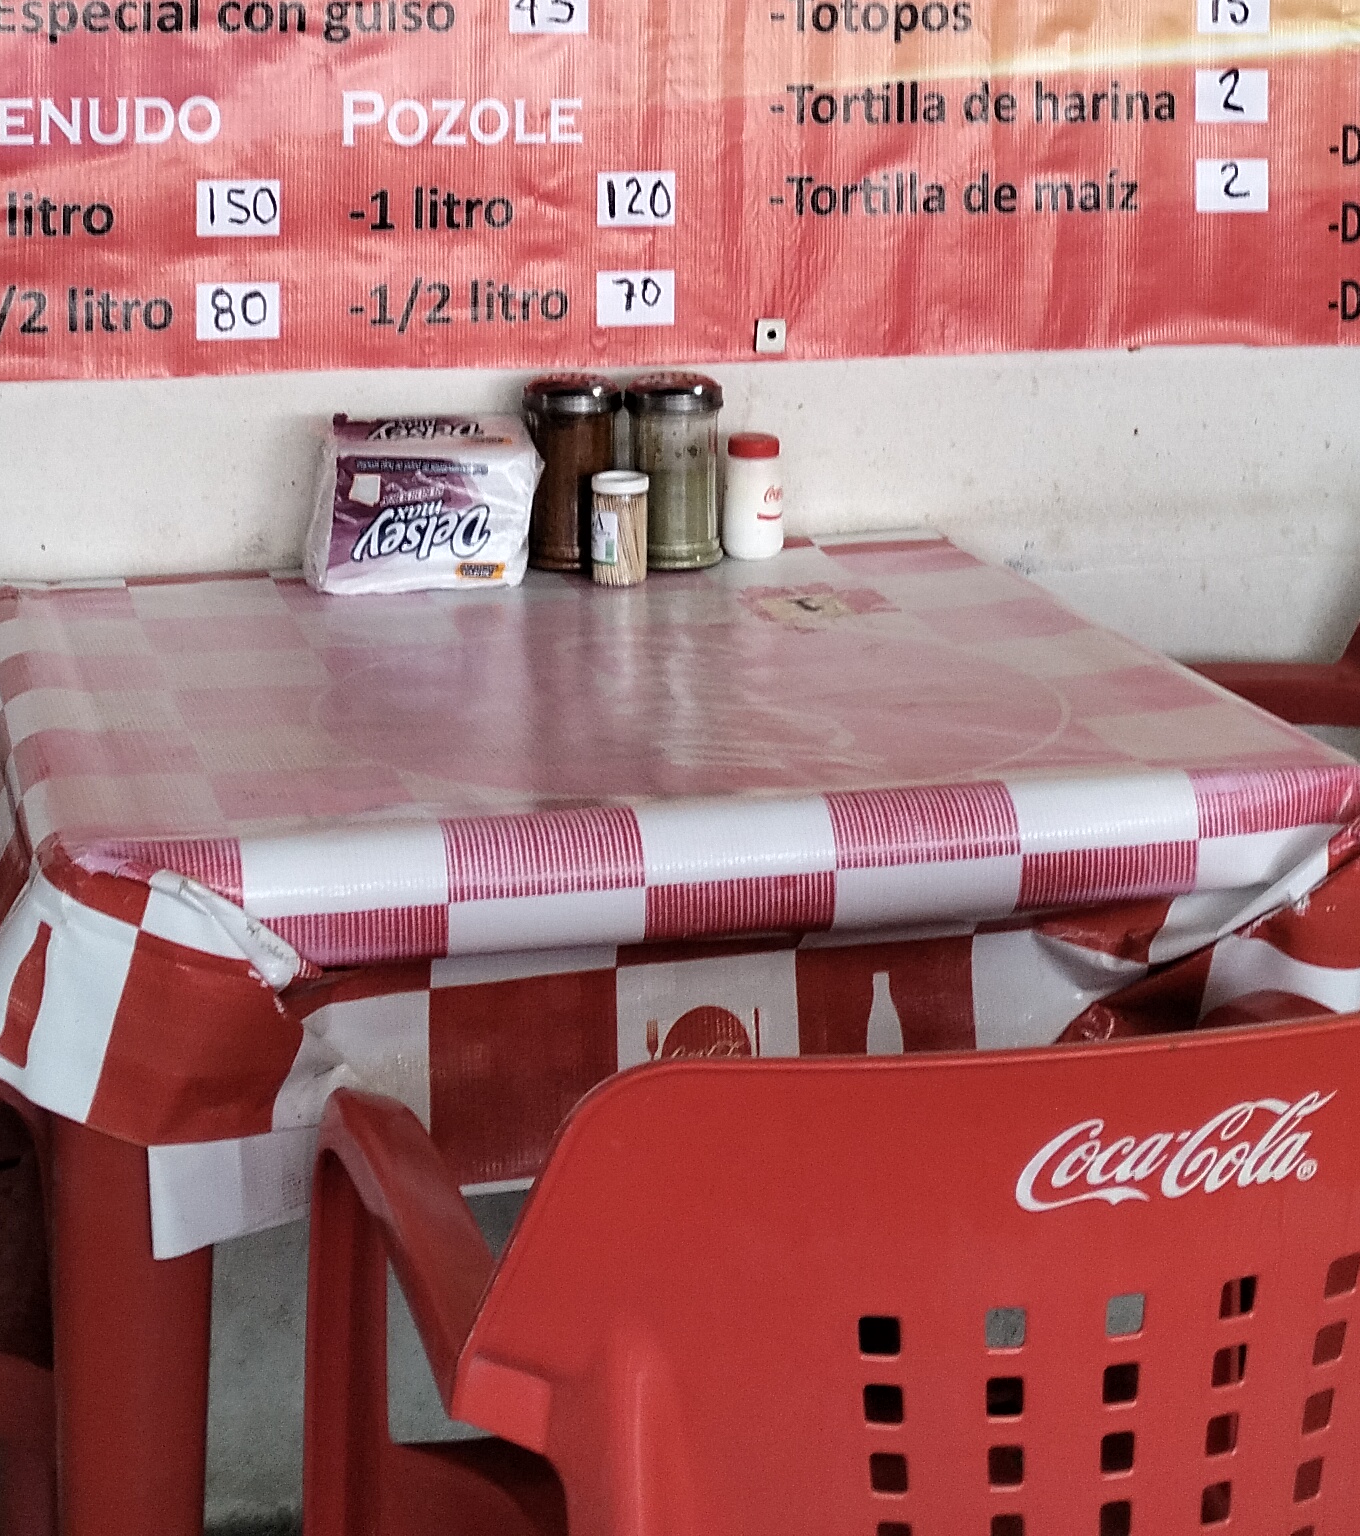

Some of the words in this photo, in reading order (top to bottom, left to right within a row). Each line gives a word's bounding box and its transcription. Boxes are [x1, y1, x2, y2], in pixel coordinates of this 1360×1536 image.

[217, 2, 306, 34] con
[963, 83, 1017, 123] de
[1035, 80, 1176, 123] harina
[1219, 69, 1244, 112] 2
[342, 89, 583, 148] POZOLE
[8, 191, 114, 237] litro
[207, 187, 278, 227] 150
[413, 187, 514, 230] litro
[606, 179, 671, 220] 120
[68, 285, 174, 332] litro
[211, 290, 267, 332] 80
[351, 505, 490, 562] Delsey
